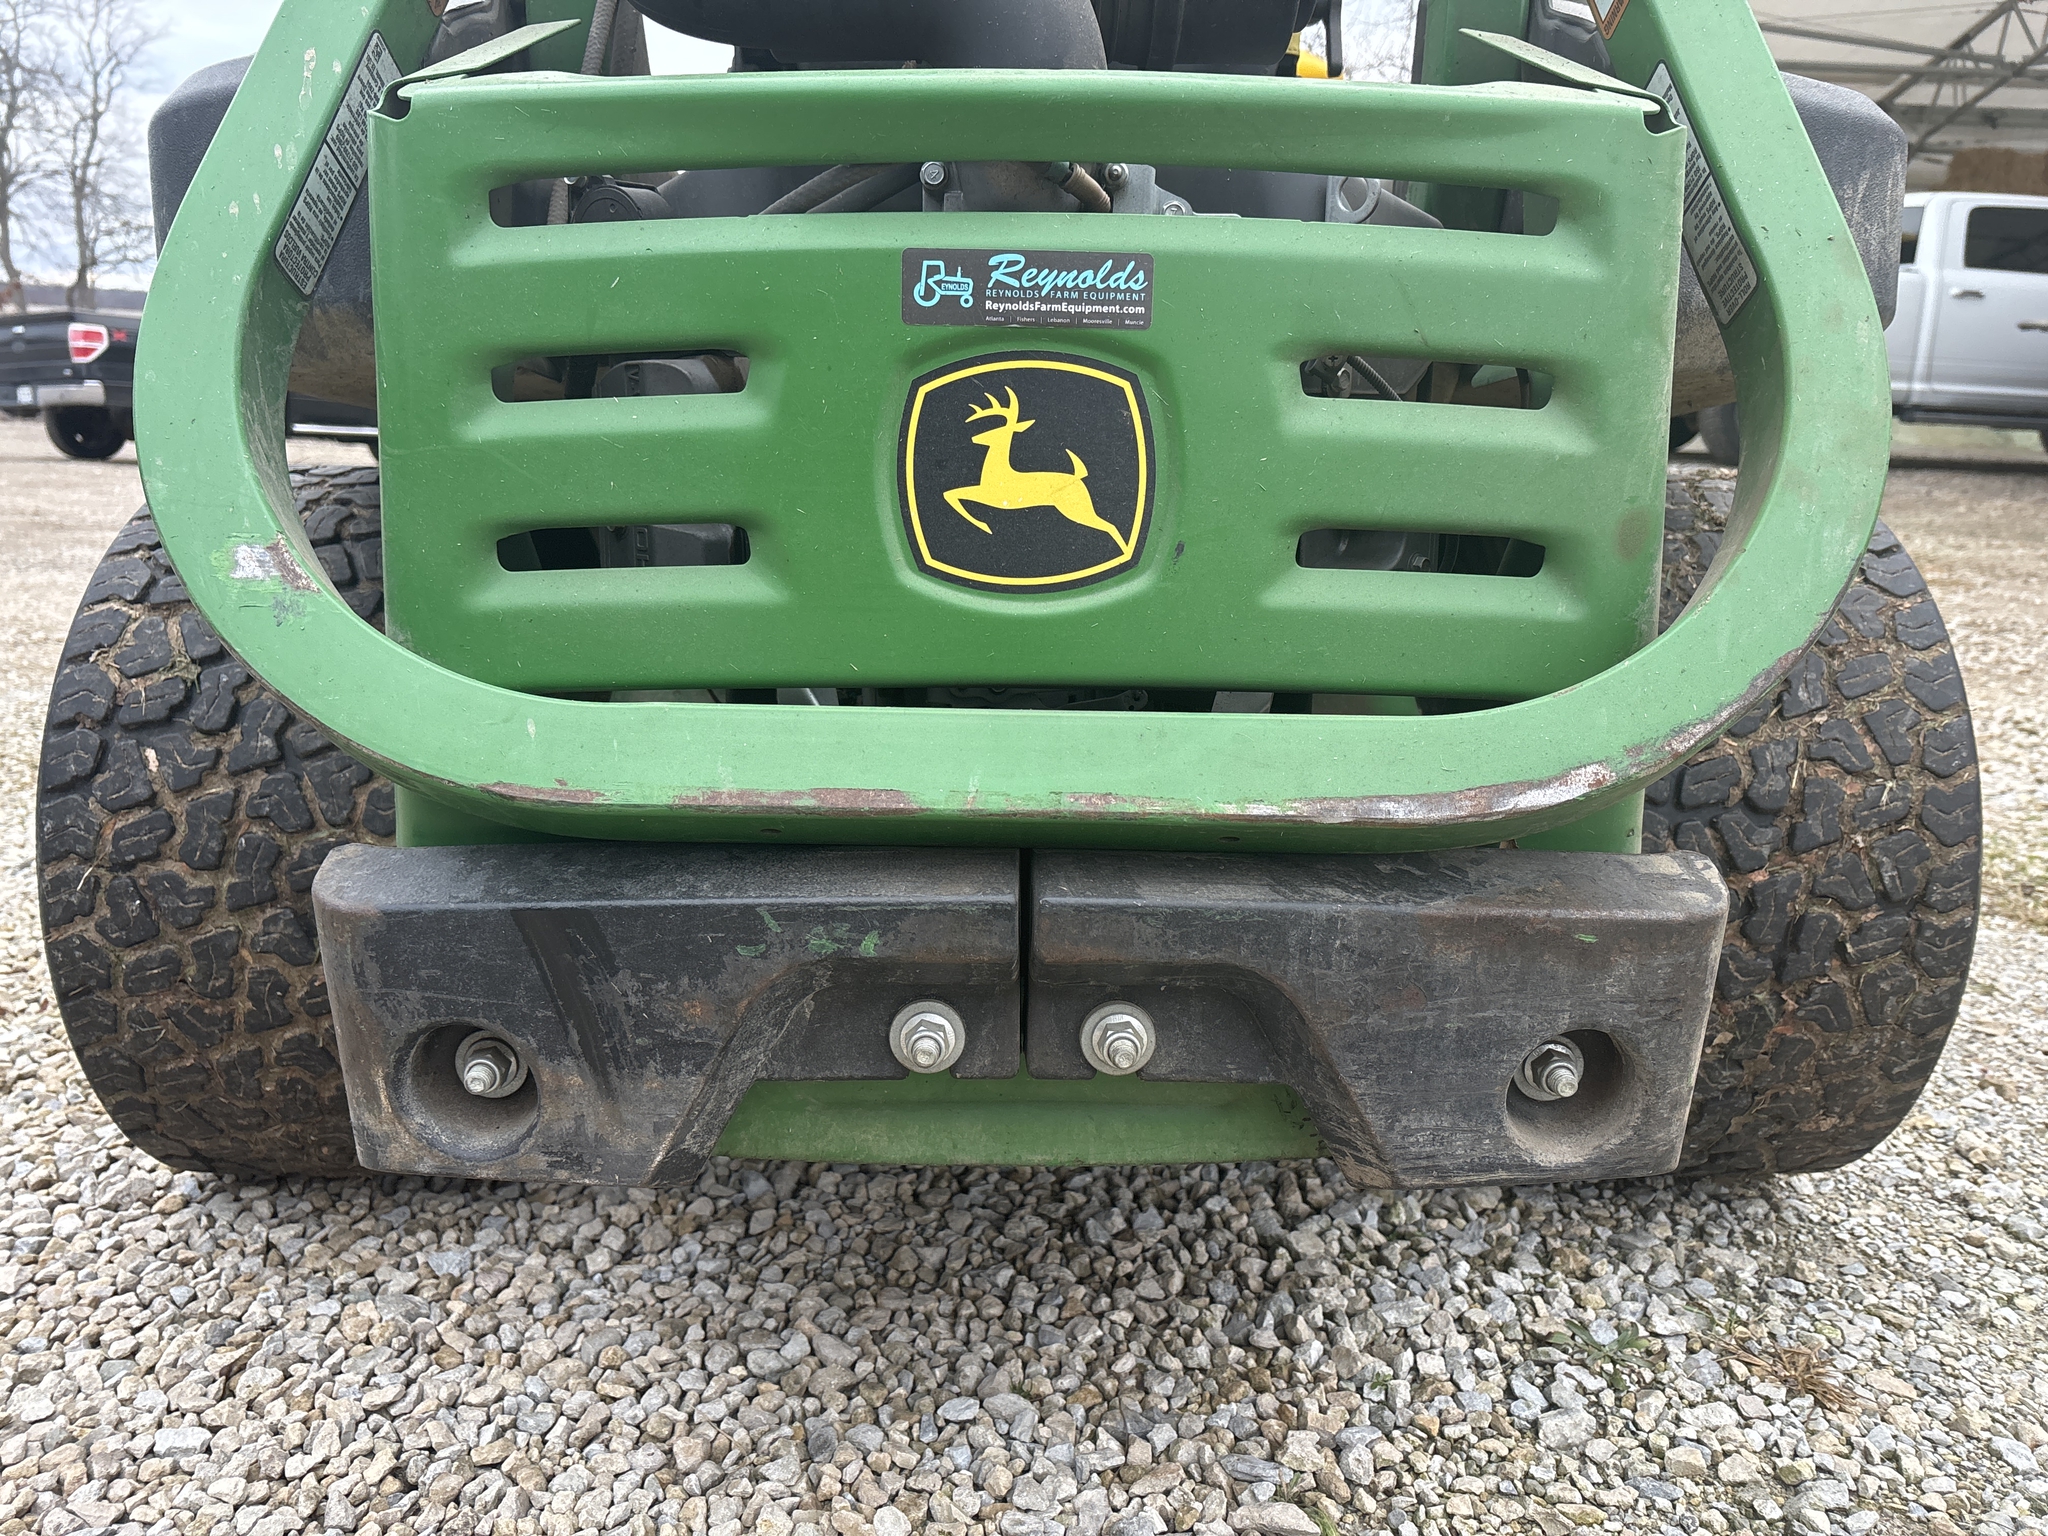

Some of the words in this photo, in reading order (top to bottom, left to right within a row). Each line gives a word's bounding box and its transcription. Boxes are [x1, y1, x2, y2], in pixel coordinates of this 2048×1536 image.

[282, 241, 311, 282] PROTECTORA
[283, 228, 302, 257] VUELCOS
[278, 249, 307, 290] ESTRUCTURA
[300, 252, 318, 278] CONTRA
[988, 253, 1148, 296] Reynolds
[1717, 260, 1743, 301] STRUCTURE
[985, 300, 1146, 315] ReynoldsFarmEquipment.com
[986, 290, 1040, 298] REYNOLDS
[1050, 290, 1078, 300] FARM
[1083, 292, 1146, 302] EQUIPMENT
[1721, 268, 1748, 311] PROTECTIVE
[1725, 278, 1751, 318] ROLL-OVER
